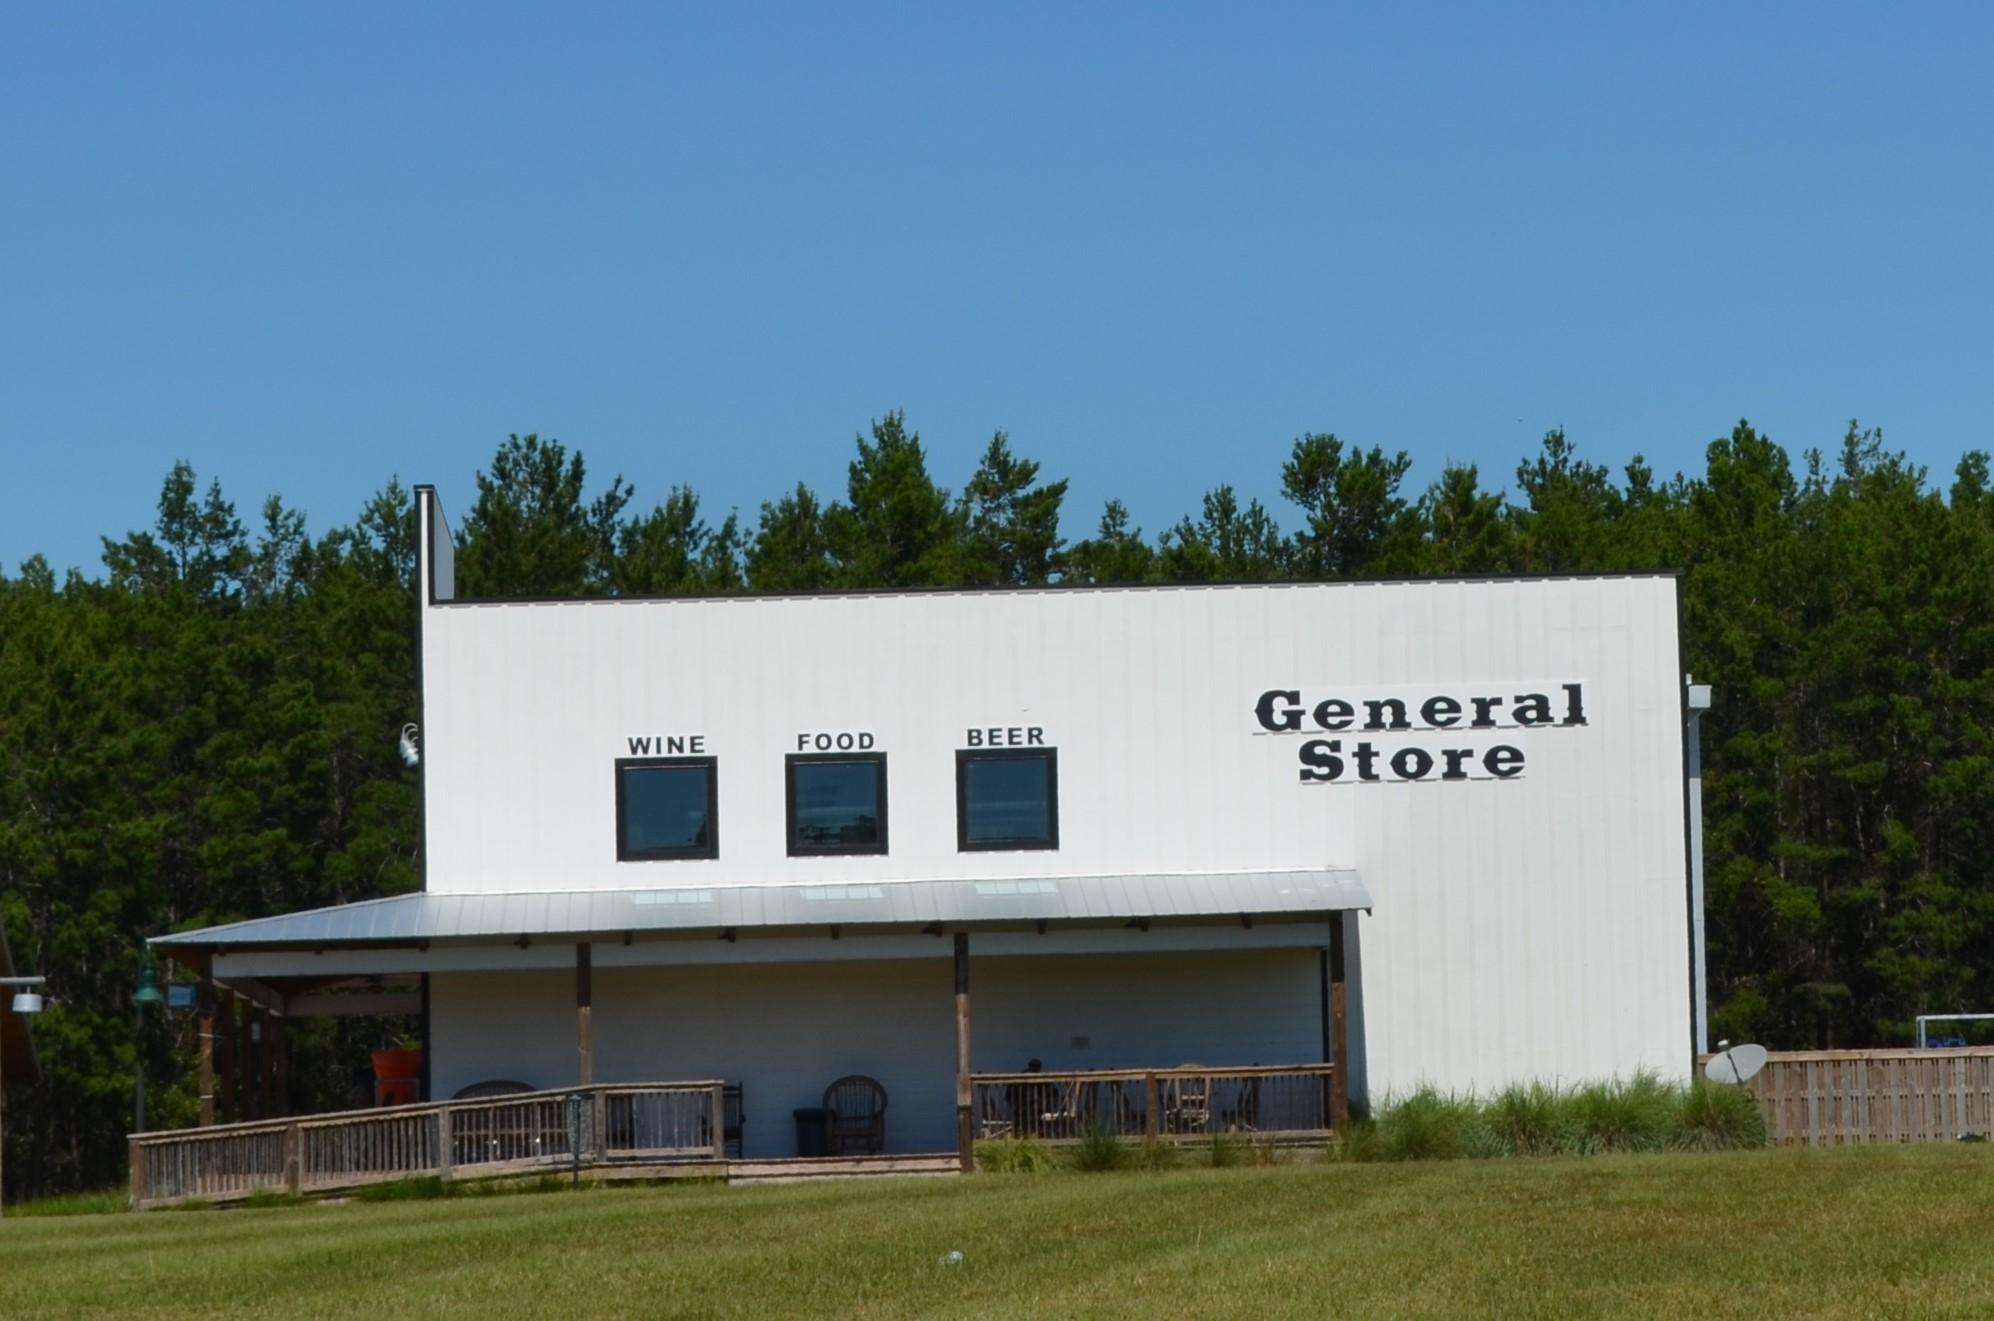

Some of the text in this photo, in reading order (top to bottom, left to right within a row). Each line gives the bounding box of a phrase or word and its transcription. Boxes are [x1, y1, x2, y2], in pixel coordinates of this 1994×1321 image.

[1254, 683, 1588, 732] General
[628, 735, 705, 754] WINE
[797, 732, 875, 751] FOOD
[967, 727, 1045, 747] BEER
[1298, 739, 1525, 781] Store
